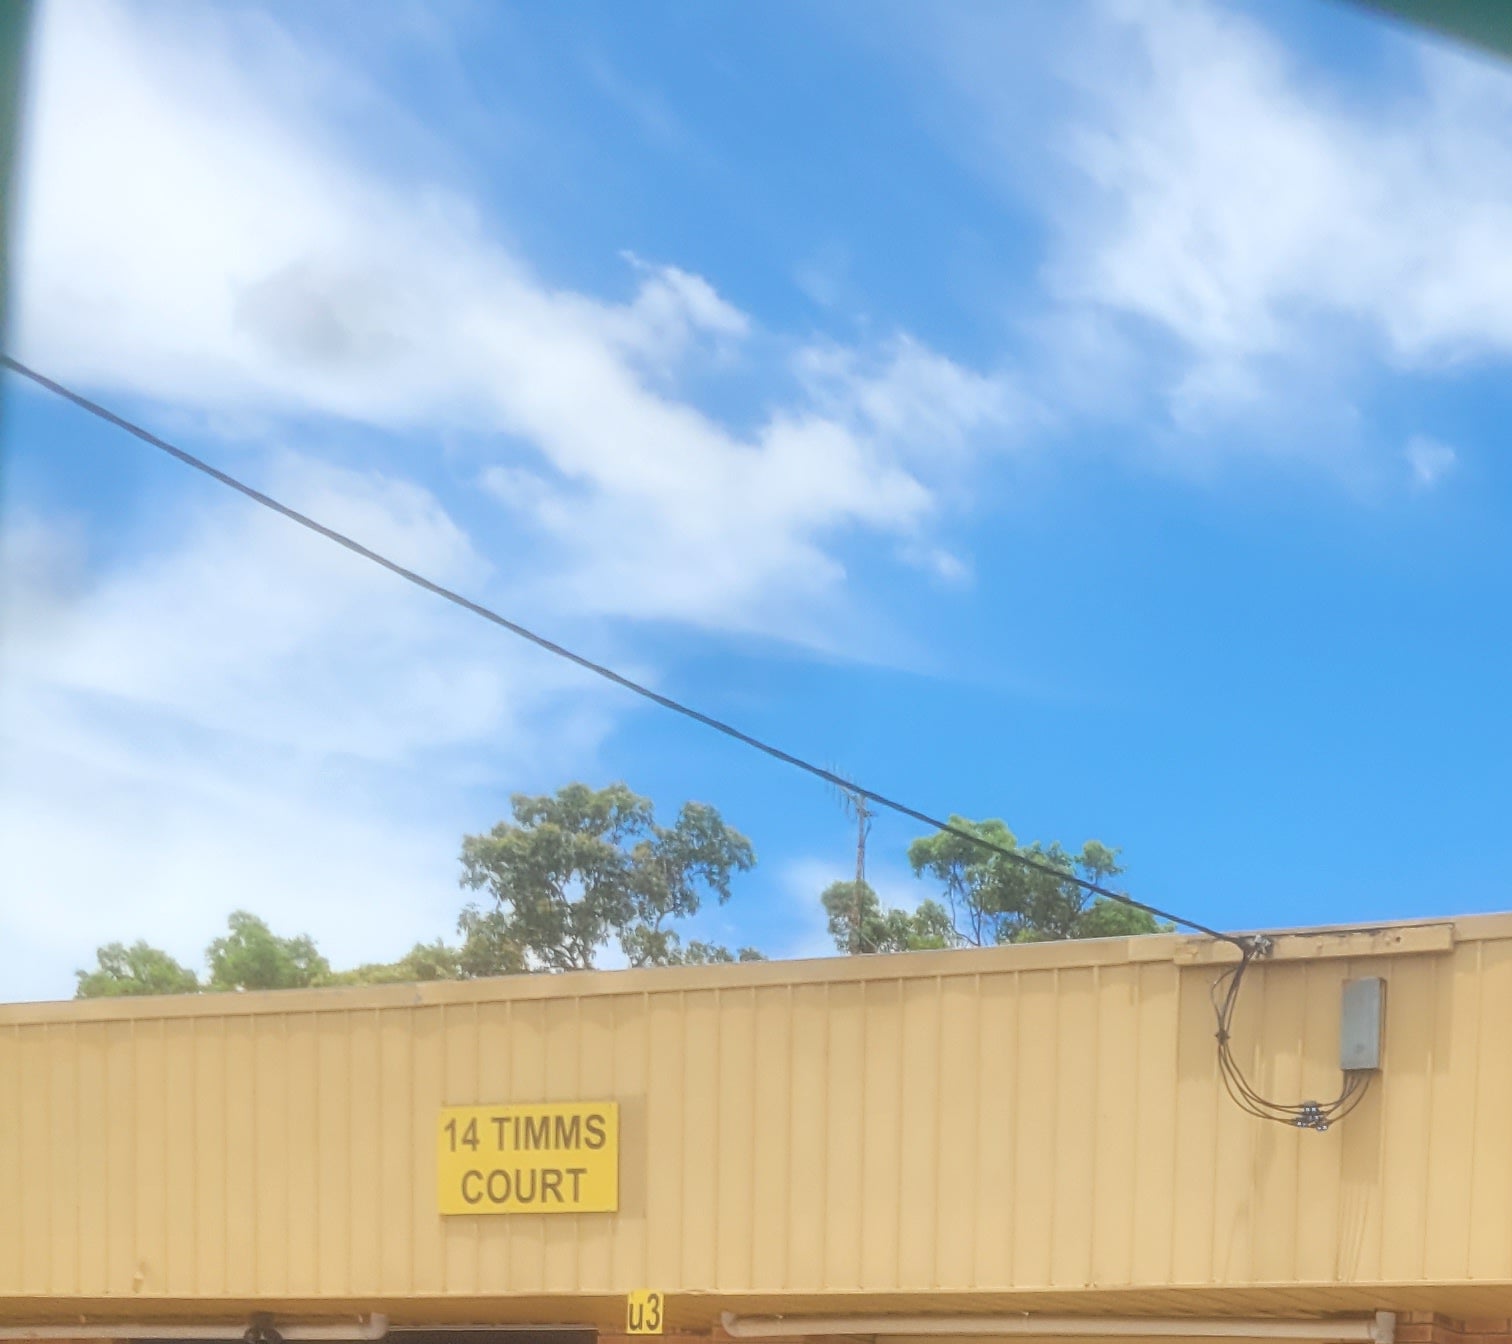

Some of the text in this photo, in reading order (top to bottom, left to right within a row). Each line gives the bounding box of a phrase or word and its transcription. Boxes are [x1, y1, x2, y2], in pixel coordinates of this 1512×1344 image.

[443, 1114, 607, 1152] 14 TIMMS
[461, 1167, 588, 1204] COURT
[628, 1292, 661, 1331] u3
